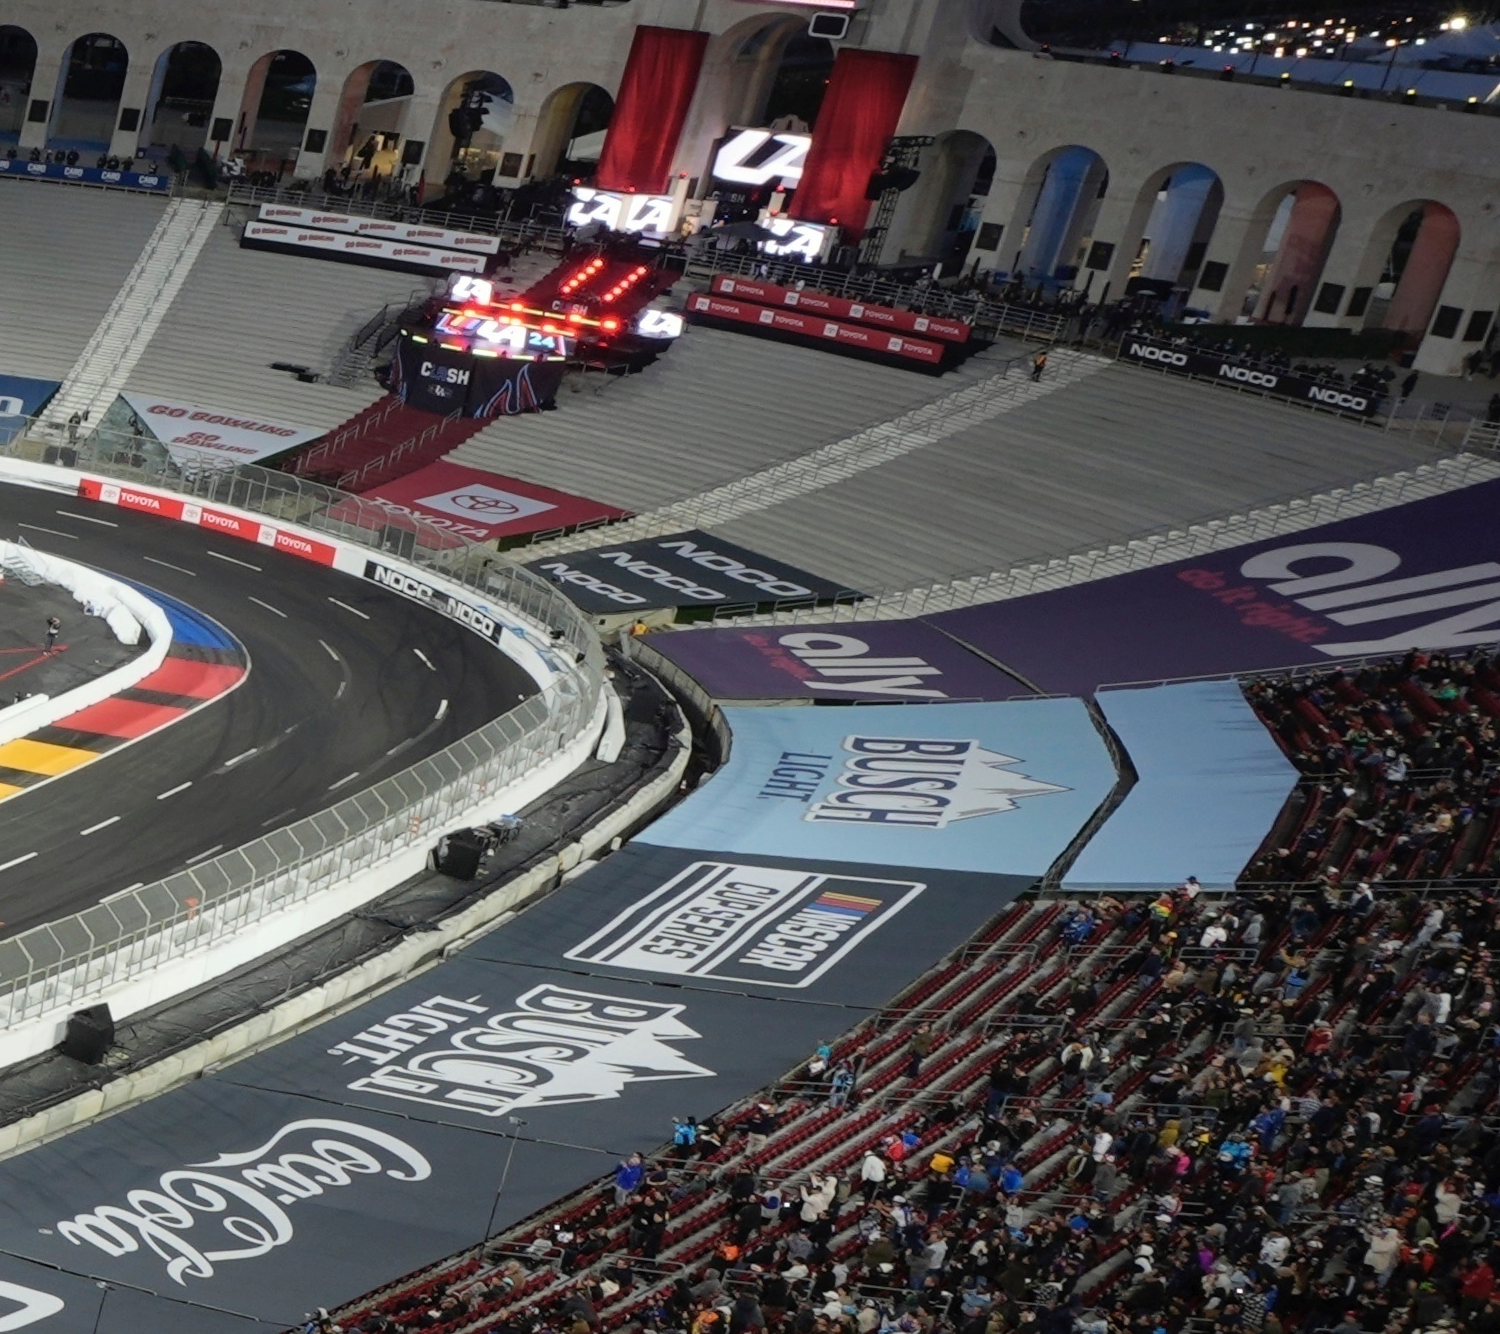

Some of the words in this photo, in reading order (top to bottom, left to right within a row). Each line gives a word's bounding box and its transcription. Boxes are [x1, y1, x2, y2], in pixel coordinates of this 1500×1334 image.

[736, 284, 765, 296] TOYOTA
[801, 296, 829, 309] TOYOTA
[865, 310, 894, 322] TOYOTA
[529, 331, 555, 348] 24
[1129, 342, 1188, 367] NOCO
[1219, 364, 1278, 388] NOCO
[1308, 386, 1367, 411] NOCO
[147, 404, 190, 419] GO
[192, 409, 299, 440] BOWLING
[186, 430, 219, 445] GO
[171, 434, 260, 456] BOWLING
[120, 491, 161, 511] TOYOTA
[368, 495, 490, 539] TOYOTA
[202, 512, 240, 531] TOYOTA
[276, 533, 313, 555] TOYOTA
[538, 563, 648, 605] NOCO
[599, 551, 727, 602] NOCO
[657, 539, 814, 598] NOCO
[1241, 541, 1500, 657] ally
[446, 600, 498, 635] NOCO
[778, 631, 951, 698] ally
[758, 749, 834, 803] LIGHT
[808, 734, 977, 829] BUSCH
[738, 904, 867, 972] NASCAR
[344, 993, 482, 1066] LIGHT
[348, 983, 687, 1116] BUSCH
[58, 1118, 432, 1287] Coca-Cola
